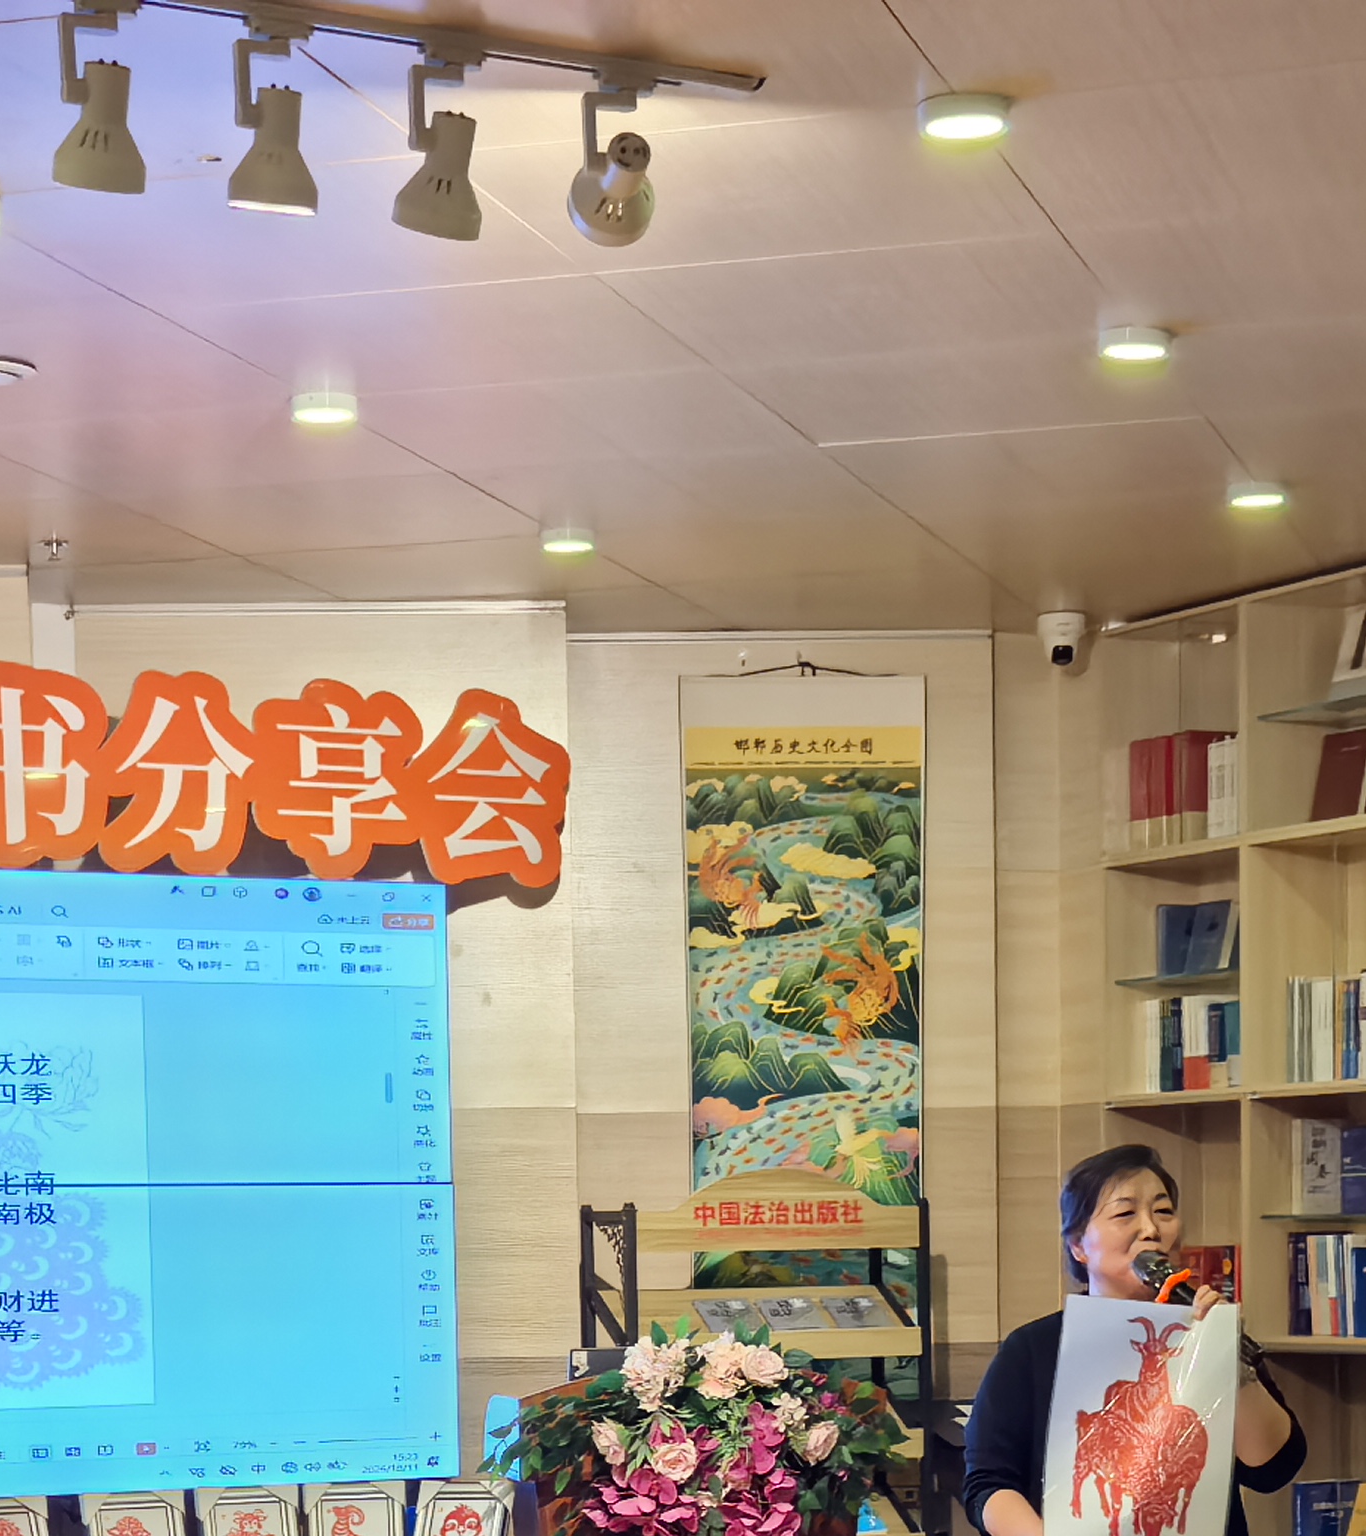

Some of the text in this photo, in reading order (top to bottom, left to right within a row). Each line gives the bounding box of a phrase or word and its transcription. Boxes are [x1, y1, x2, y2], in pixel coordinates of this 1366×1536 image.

[692, 1200, 864, 1227] 中国法治出版社
